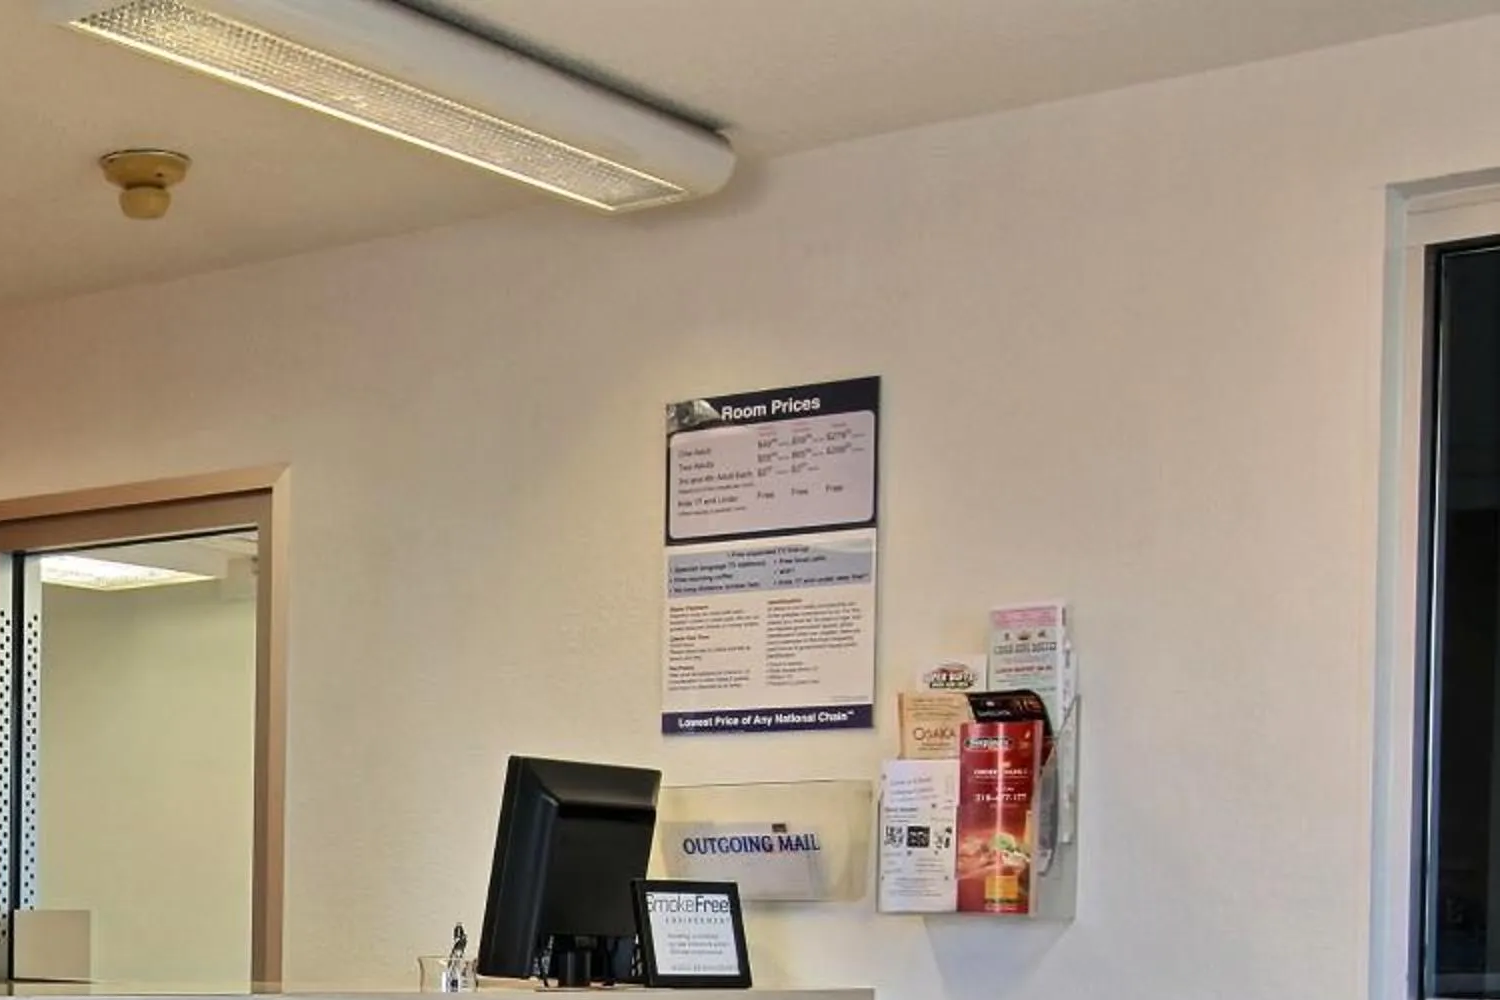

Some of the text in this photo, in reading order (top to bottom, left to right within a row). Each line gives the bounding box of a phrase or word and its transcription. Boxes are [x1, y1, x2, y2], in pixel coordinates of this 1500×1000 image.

[721, 396, 821, 420] Room Prices
[678, 711, 848, 728] Lowest Price of Any National Chain
[683, 833, 821, 855] OUTGOING MAIL
